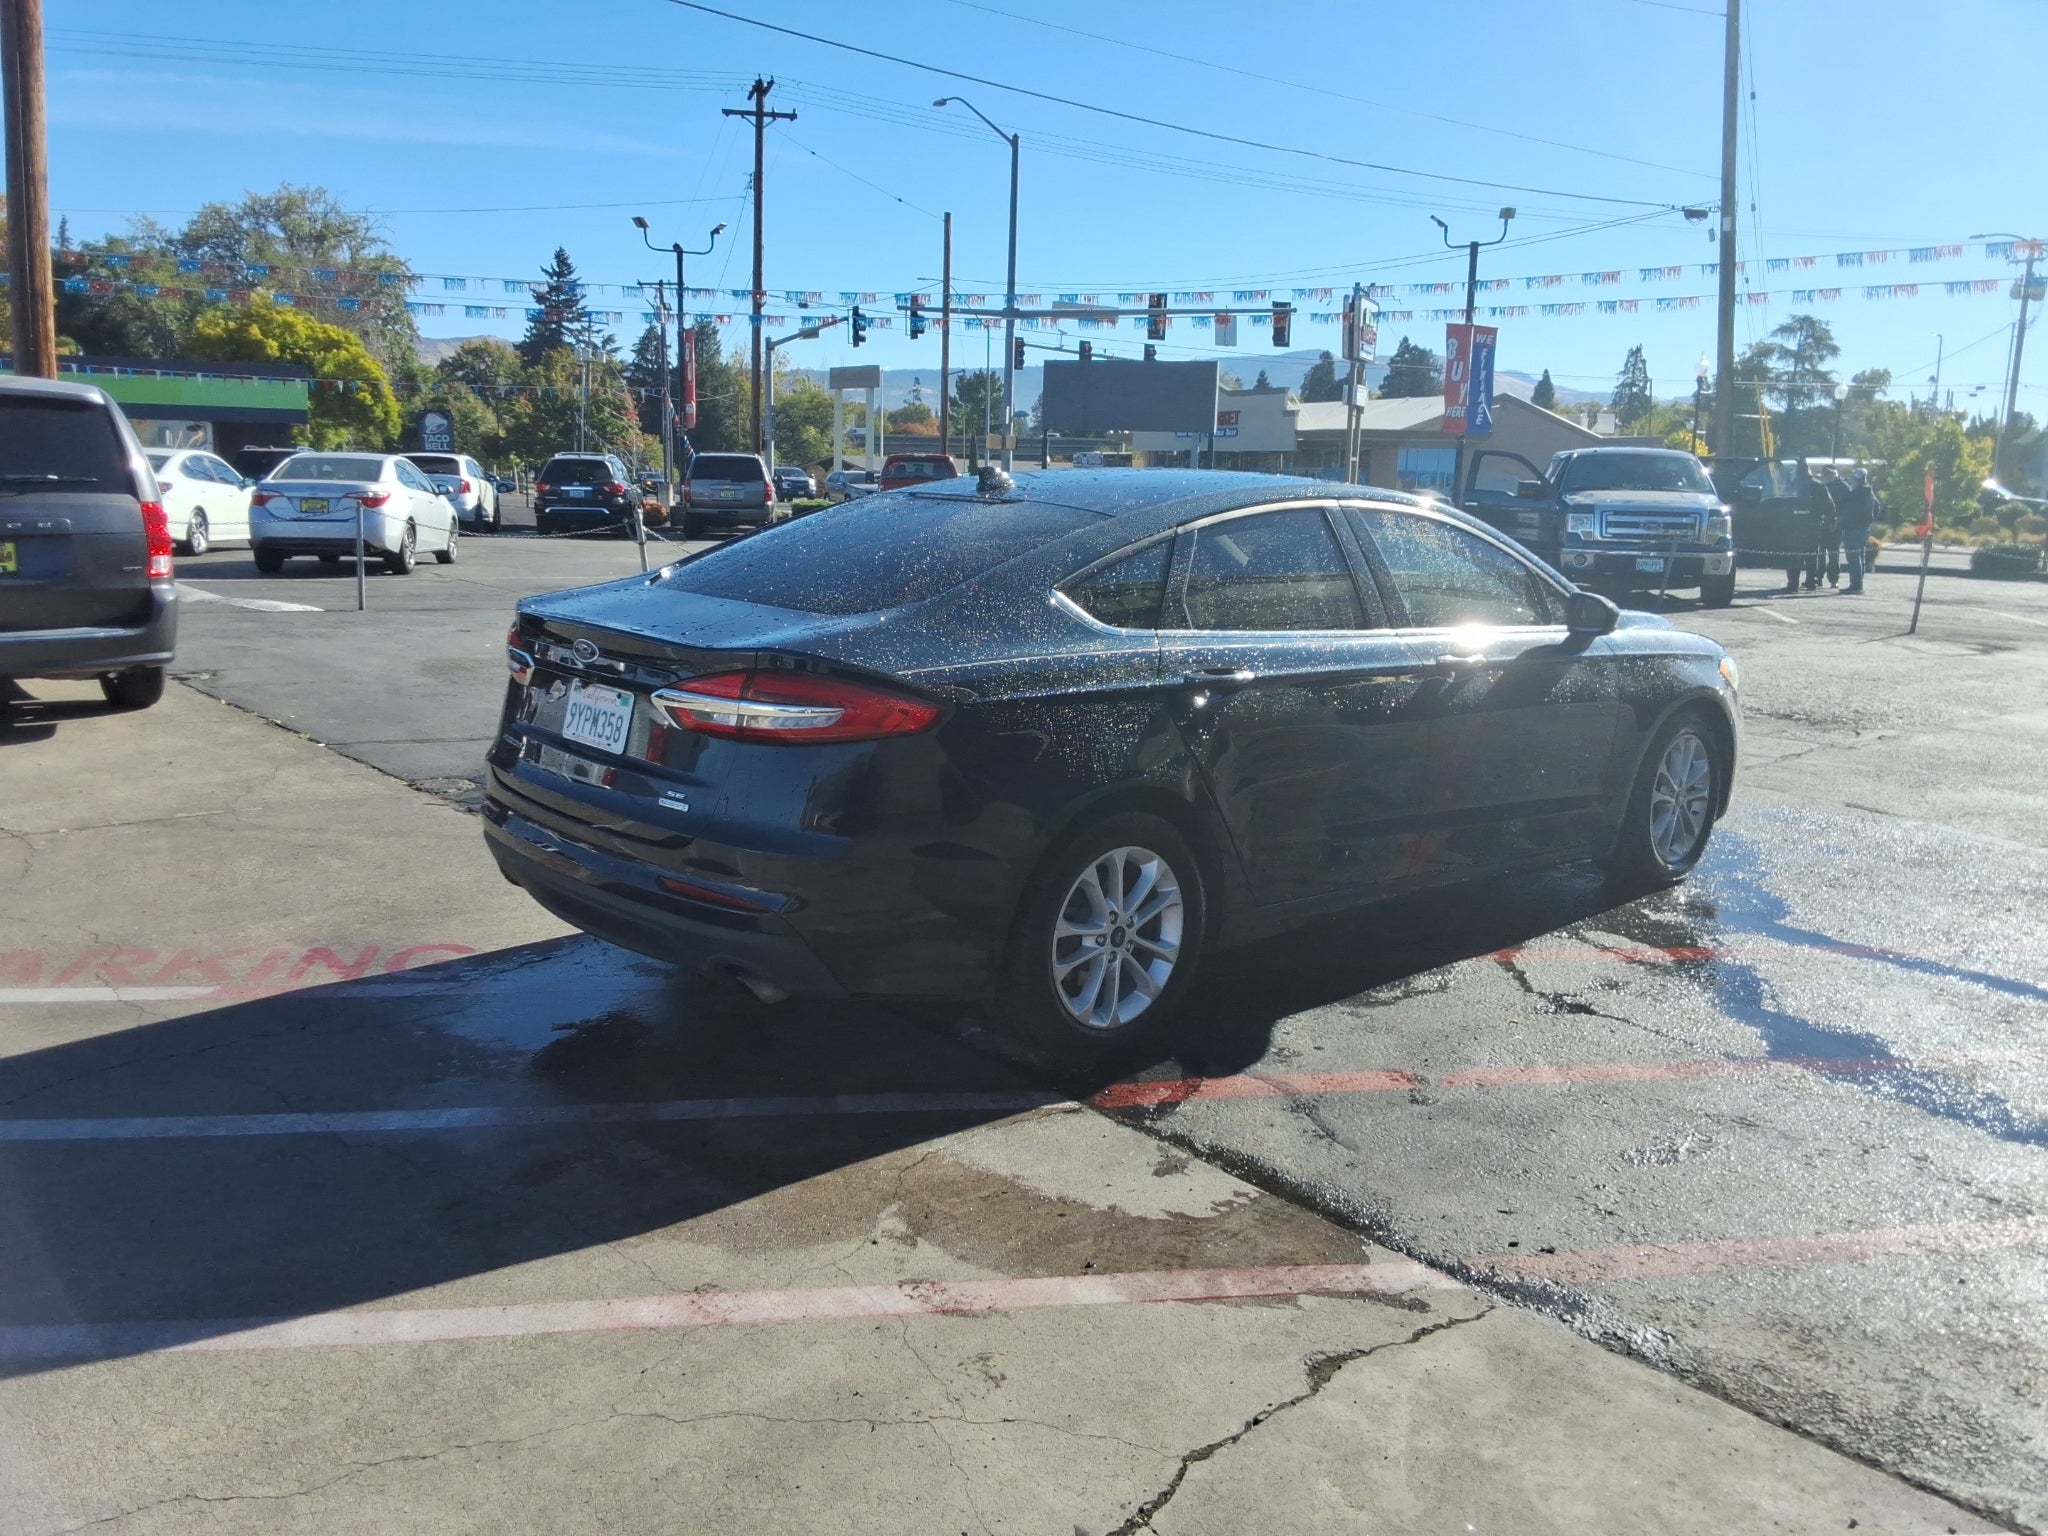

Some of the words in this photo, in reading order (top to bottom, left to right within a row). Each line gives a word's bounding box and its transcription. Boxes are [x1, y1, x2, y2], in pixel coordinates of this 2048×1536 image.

[1476, 333, 1494, 345] WE
[1447, 338, 1468, 405] BUY
[1475, 348, 1489, 425] FINANCE
[1445, 406, 1467, 417] HERE
[422, 434, 450, 443] TACO
[425, 442, 450, 451] BELL
[566, 702, 624, 743] 9YPM358
